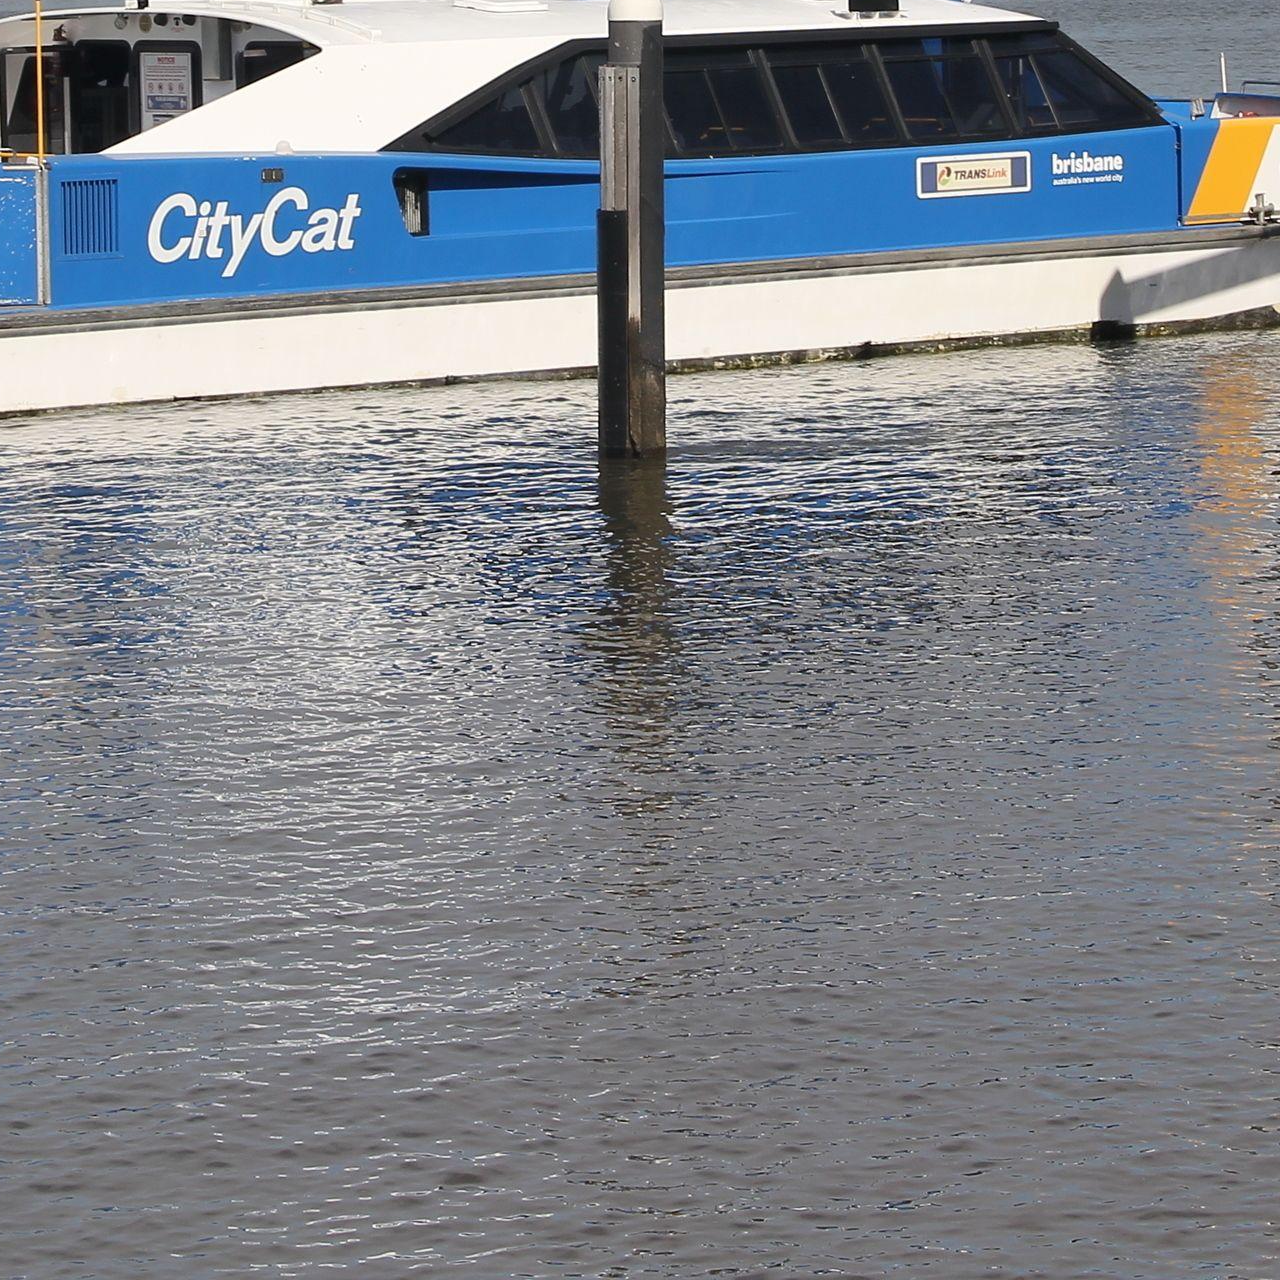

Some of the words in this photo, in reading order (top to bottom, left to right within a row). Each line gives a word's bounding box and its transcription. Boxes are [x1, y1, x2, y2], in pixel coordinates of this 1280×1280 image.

[1052, 151, 1124, 175] brisbane
[954, 167, 1008, 180] TRANSLink
[1052, 176, 1082, 186] australia's
[1095, 174, 1112, 182] world
[1112, 173, 1124, 183] city
[148, 186, 362, 278] CityCat
